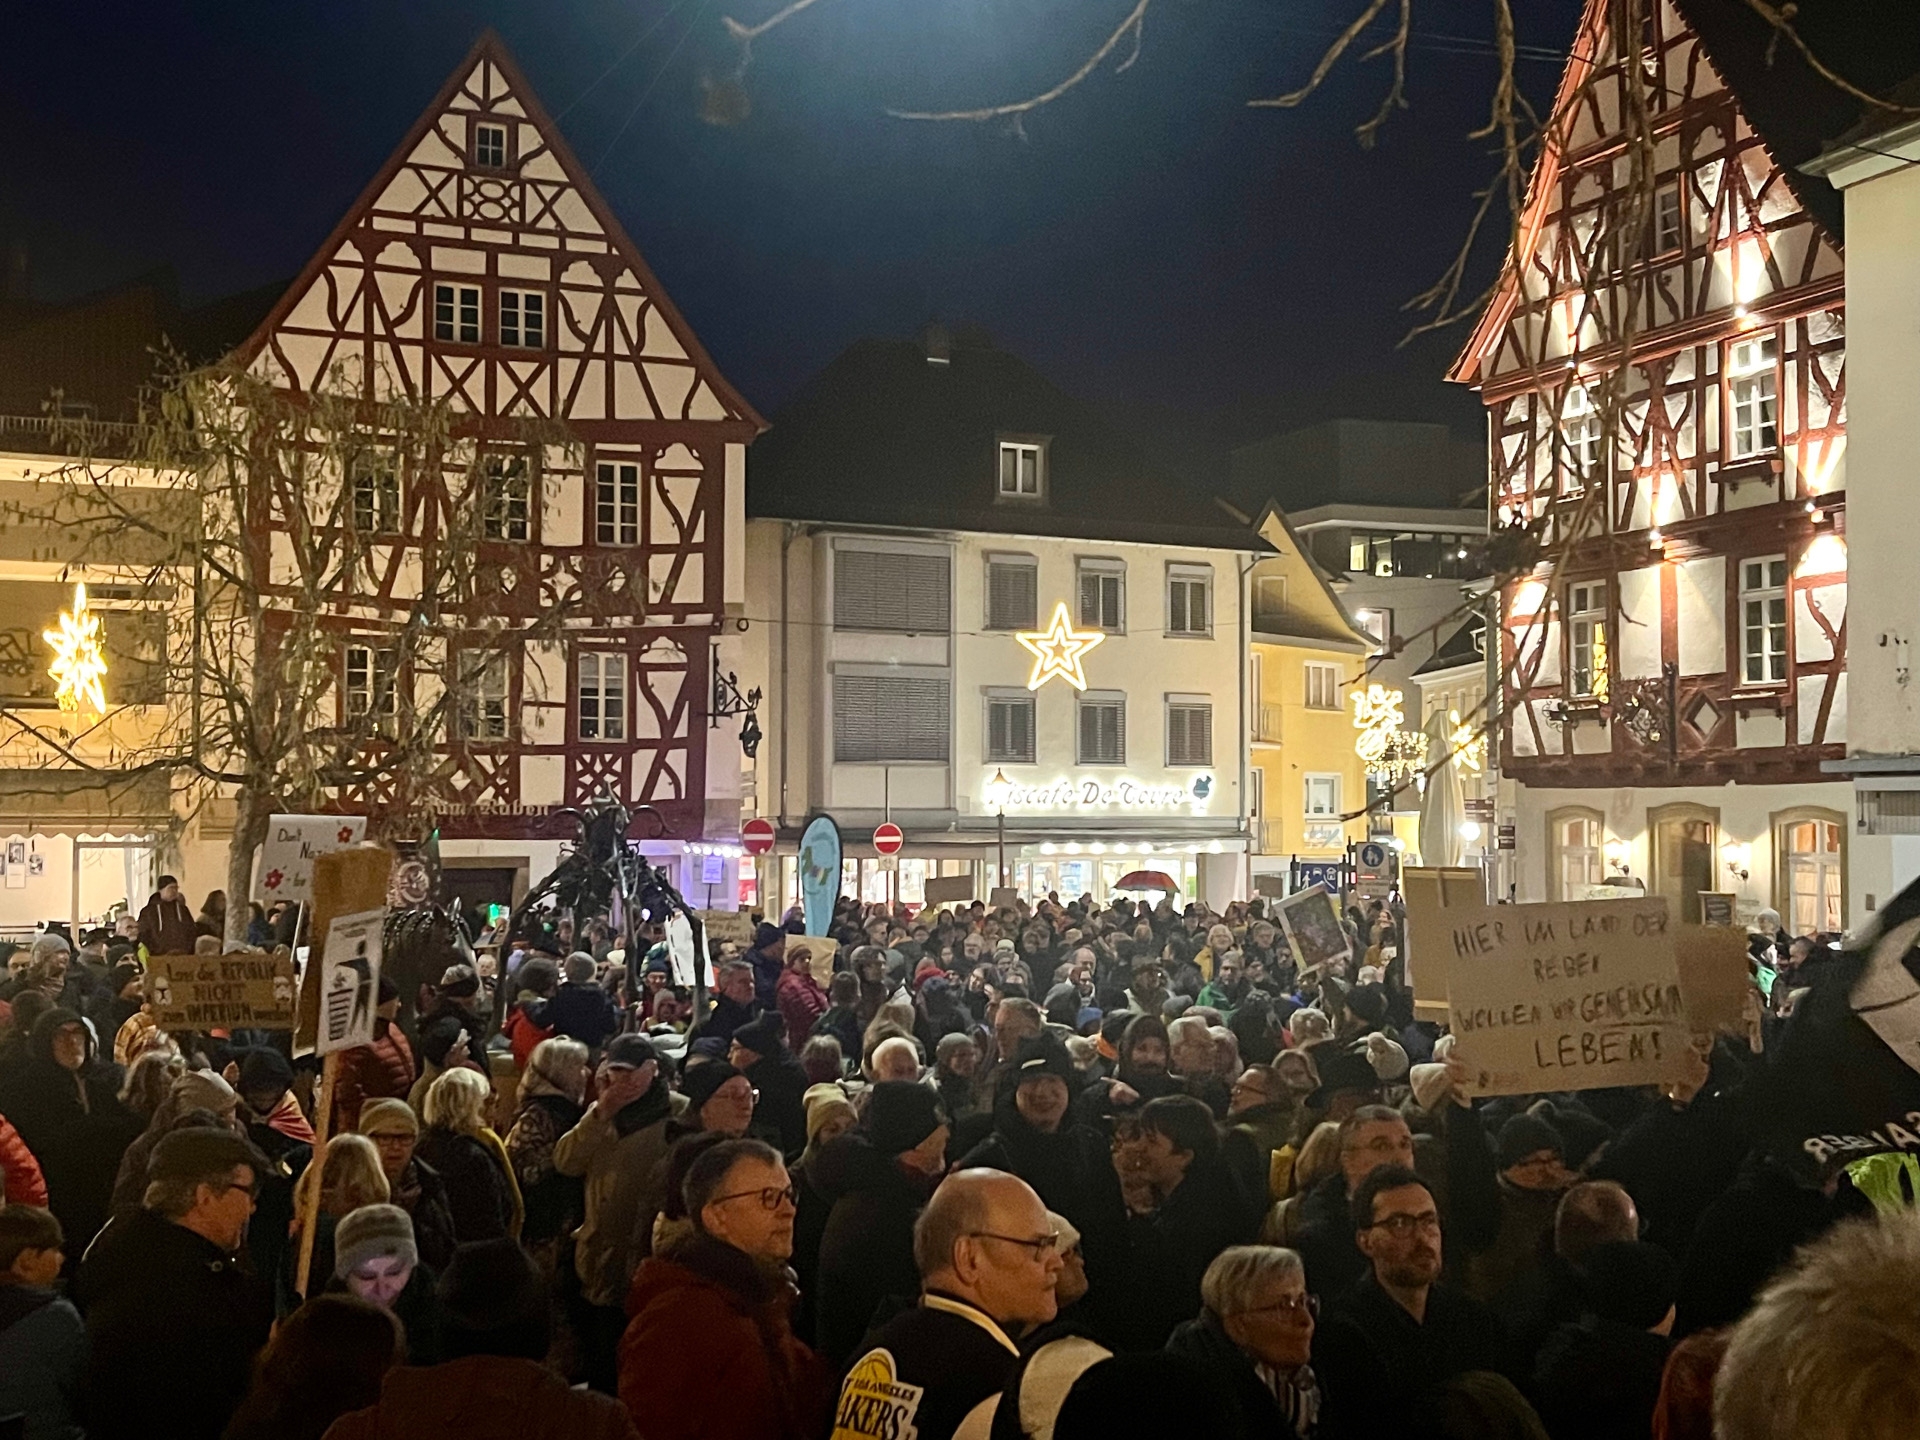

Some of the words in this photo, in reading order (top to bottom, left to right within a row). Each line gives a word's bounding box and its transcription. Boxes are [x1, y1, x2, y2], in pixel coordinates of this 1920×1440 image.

[987, 781, 1073, 804] iscafe
[1083, 782, 1112, 804] De
[1453, 920, 1507, 958] HIER
[1534, 1032, 1663, 1068] LEBEN!
